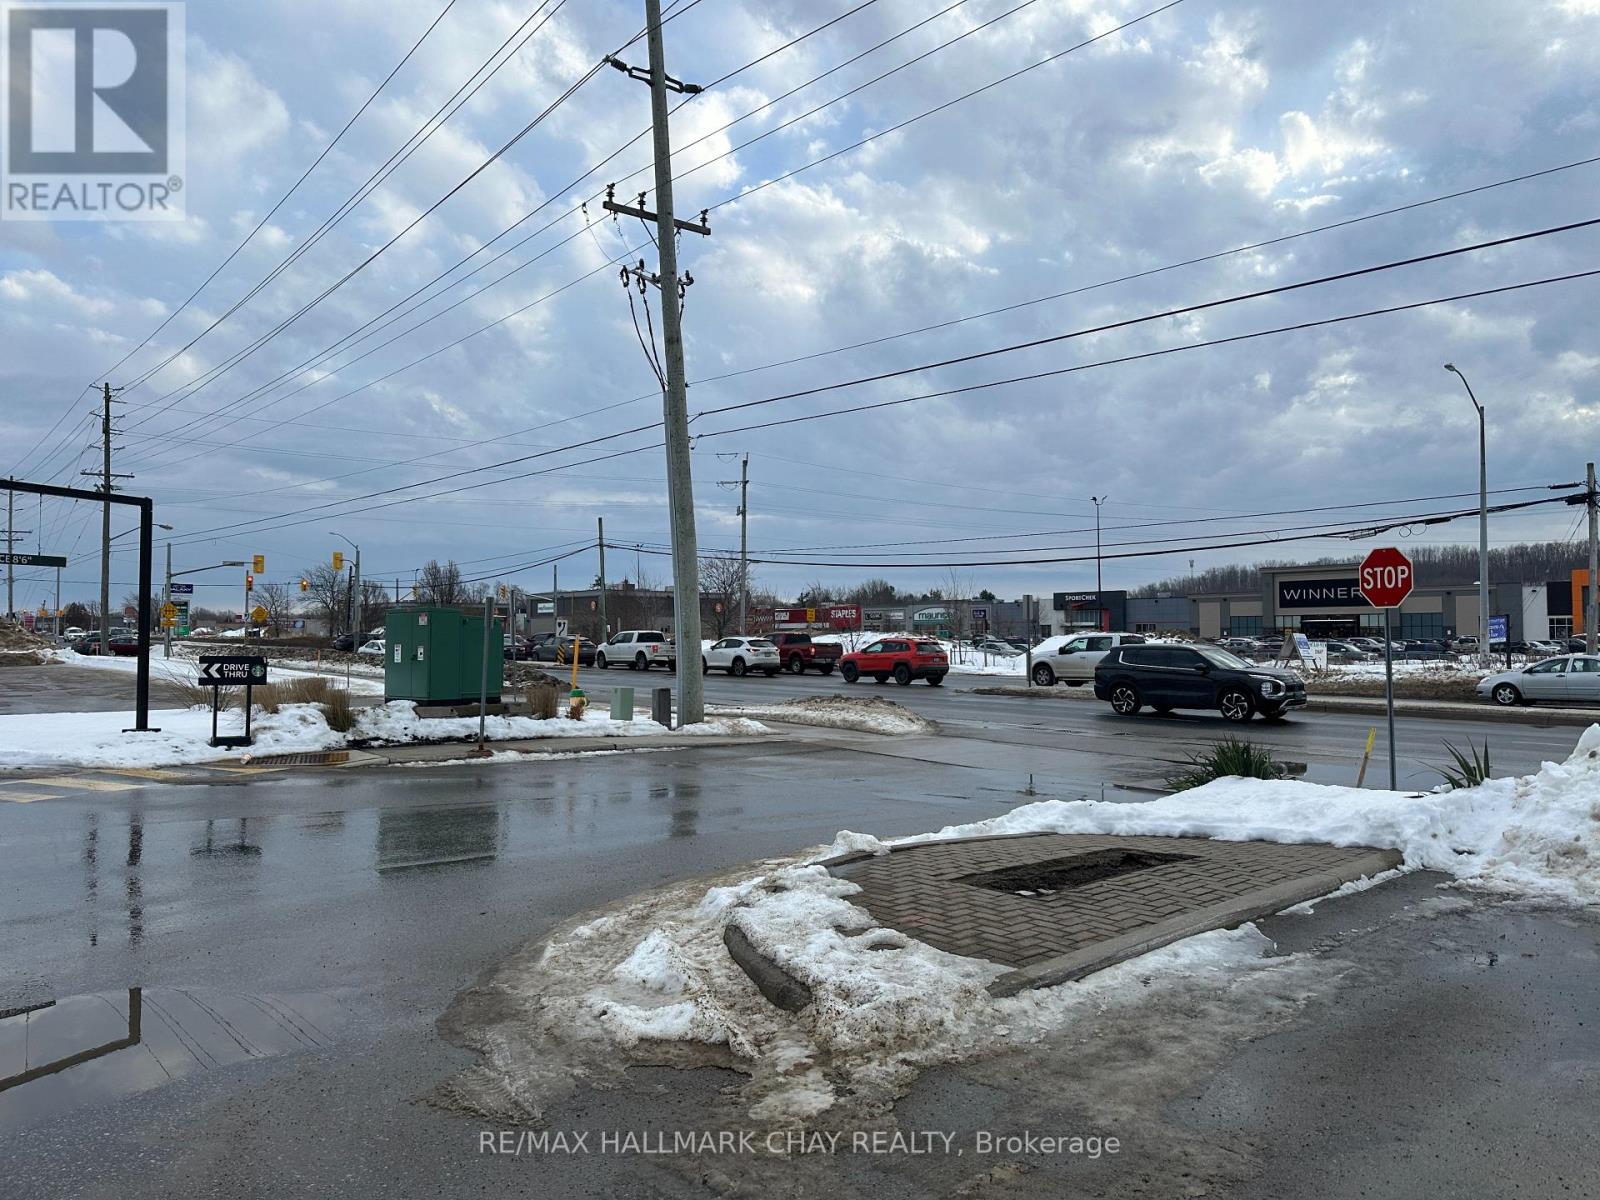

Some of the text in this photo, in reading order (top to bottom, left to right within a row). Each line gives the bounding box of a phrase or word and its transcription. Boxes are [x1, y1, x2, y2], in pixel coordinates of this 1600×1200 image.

[1363, 565, 1409, 590] STOP
[1283, 586, 1363, 600] WINNER
[830, 608, 857, 619] STAPLES
[223, 663, 250, 671] DRIVE
[223, 670, 248, 678] THRU
